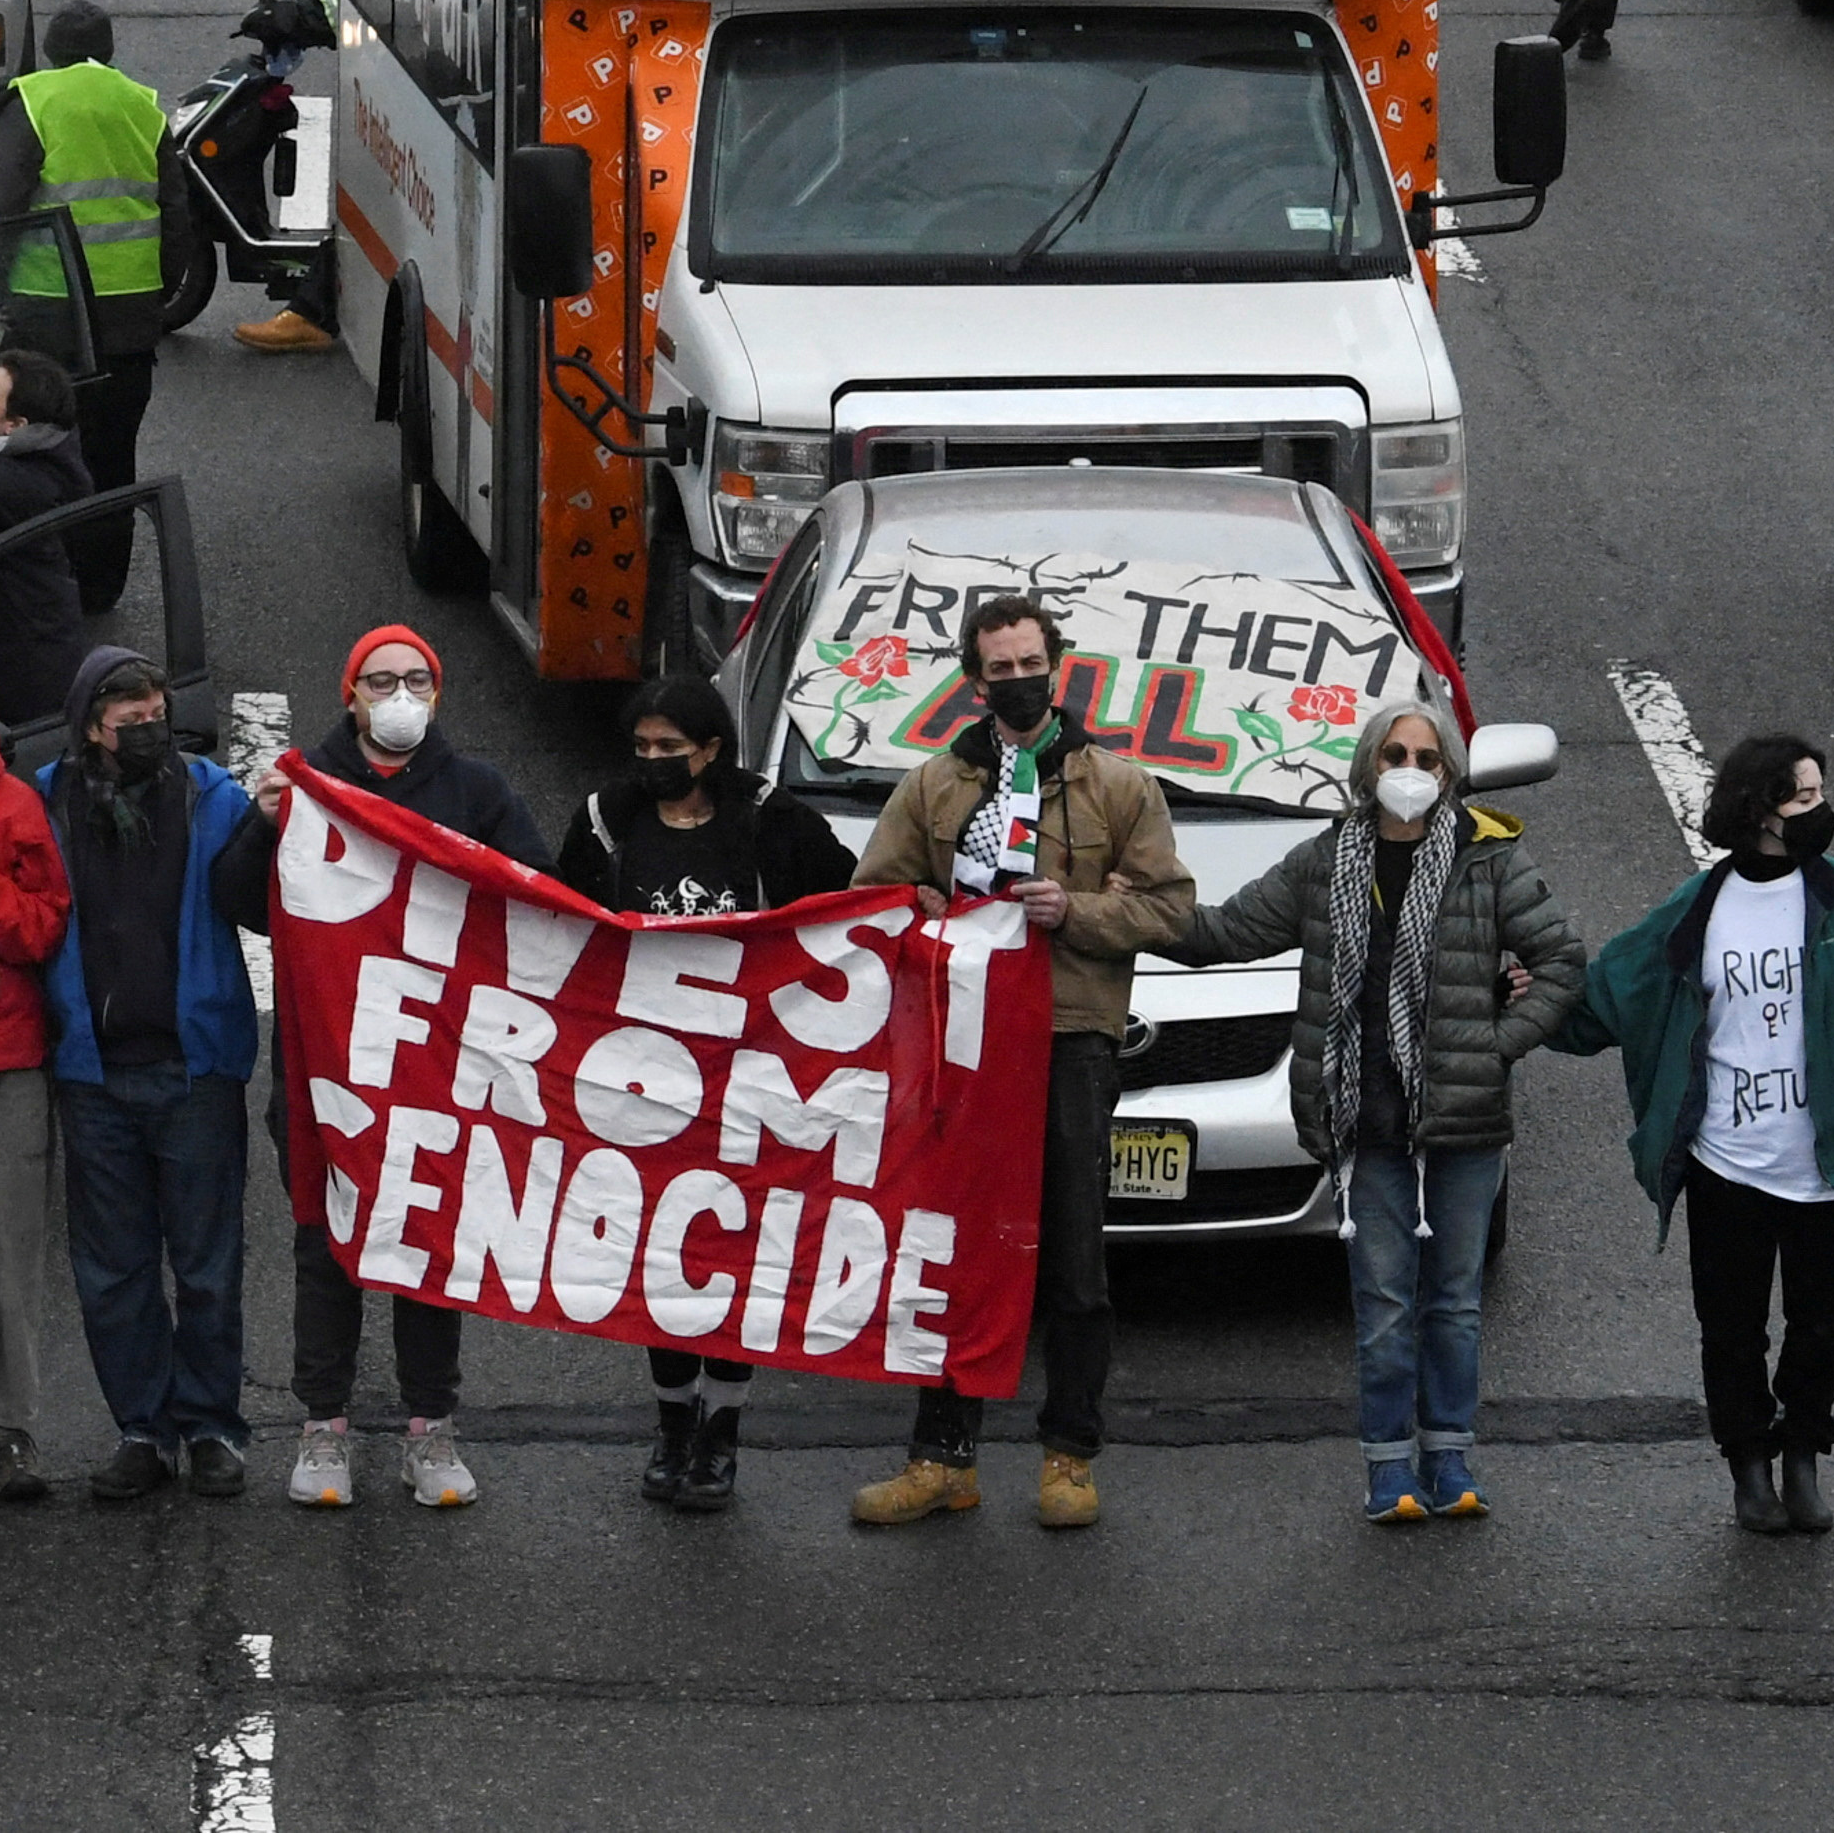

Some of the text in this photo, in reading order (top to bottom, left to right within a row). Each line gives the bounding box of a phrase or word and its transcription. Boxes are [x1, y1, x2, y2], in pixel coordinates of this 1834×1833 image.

[1125, 589, 1406, 696] THEM
[279, 782, 1029, 1071] DIVEST
[1723, 946, 1804, 1003] RIGH
[348, 954, 890, 1189] FROM
[1733, 1067, 1807, 1128] RETU
[1114, 1130, 1152, 1142] Jersey
[1127, 1146, 1178, 1181] HYG
[1123, 1183, 1151, 1193] State
[310, 1078, 955, 1375] GENOCIDE
